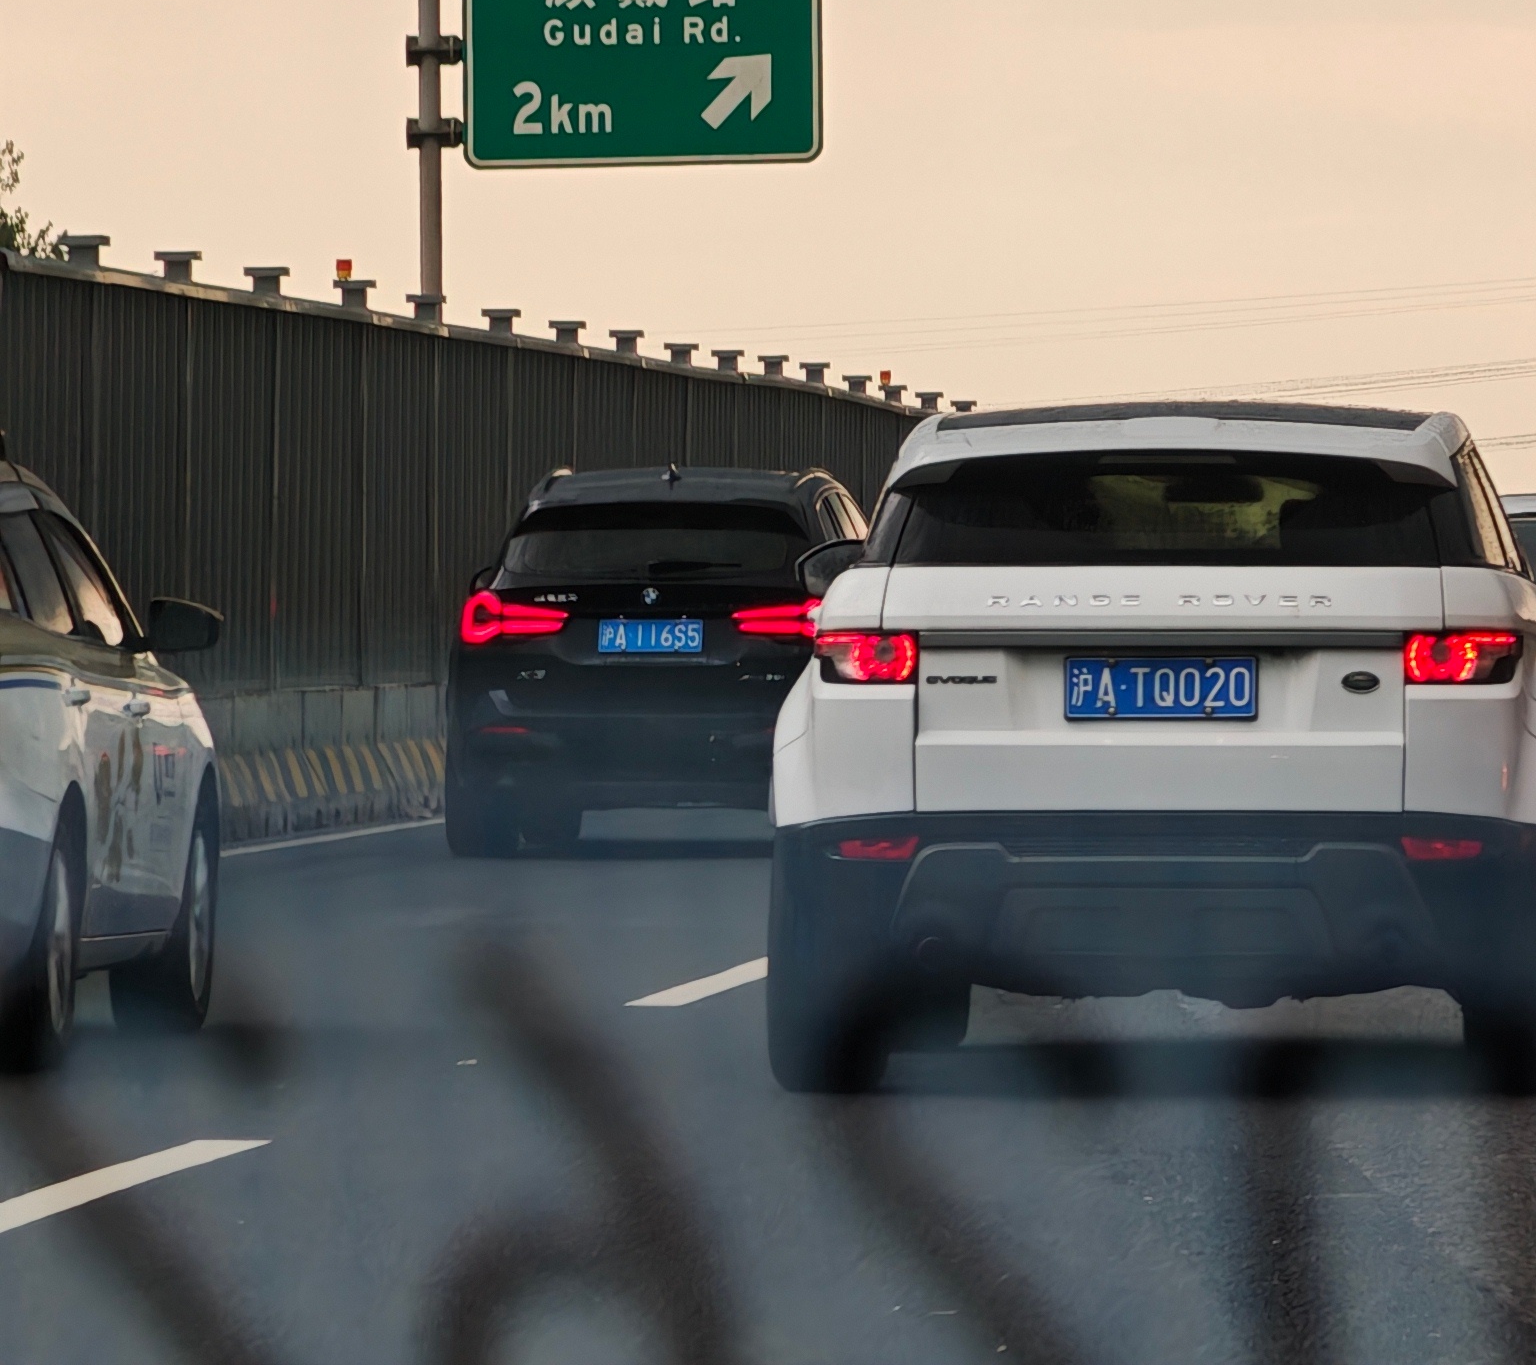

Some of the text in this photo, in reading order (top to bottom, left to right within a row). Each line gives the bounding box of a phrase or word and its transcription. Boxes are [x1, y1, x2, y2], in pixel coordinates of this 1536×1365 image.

[543, 16, 741, 46] Gudai Rd.
[512, 80, 613, 135] 2km
[986, 593, 1333, 608] RANGE ROVER
